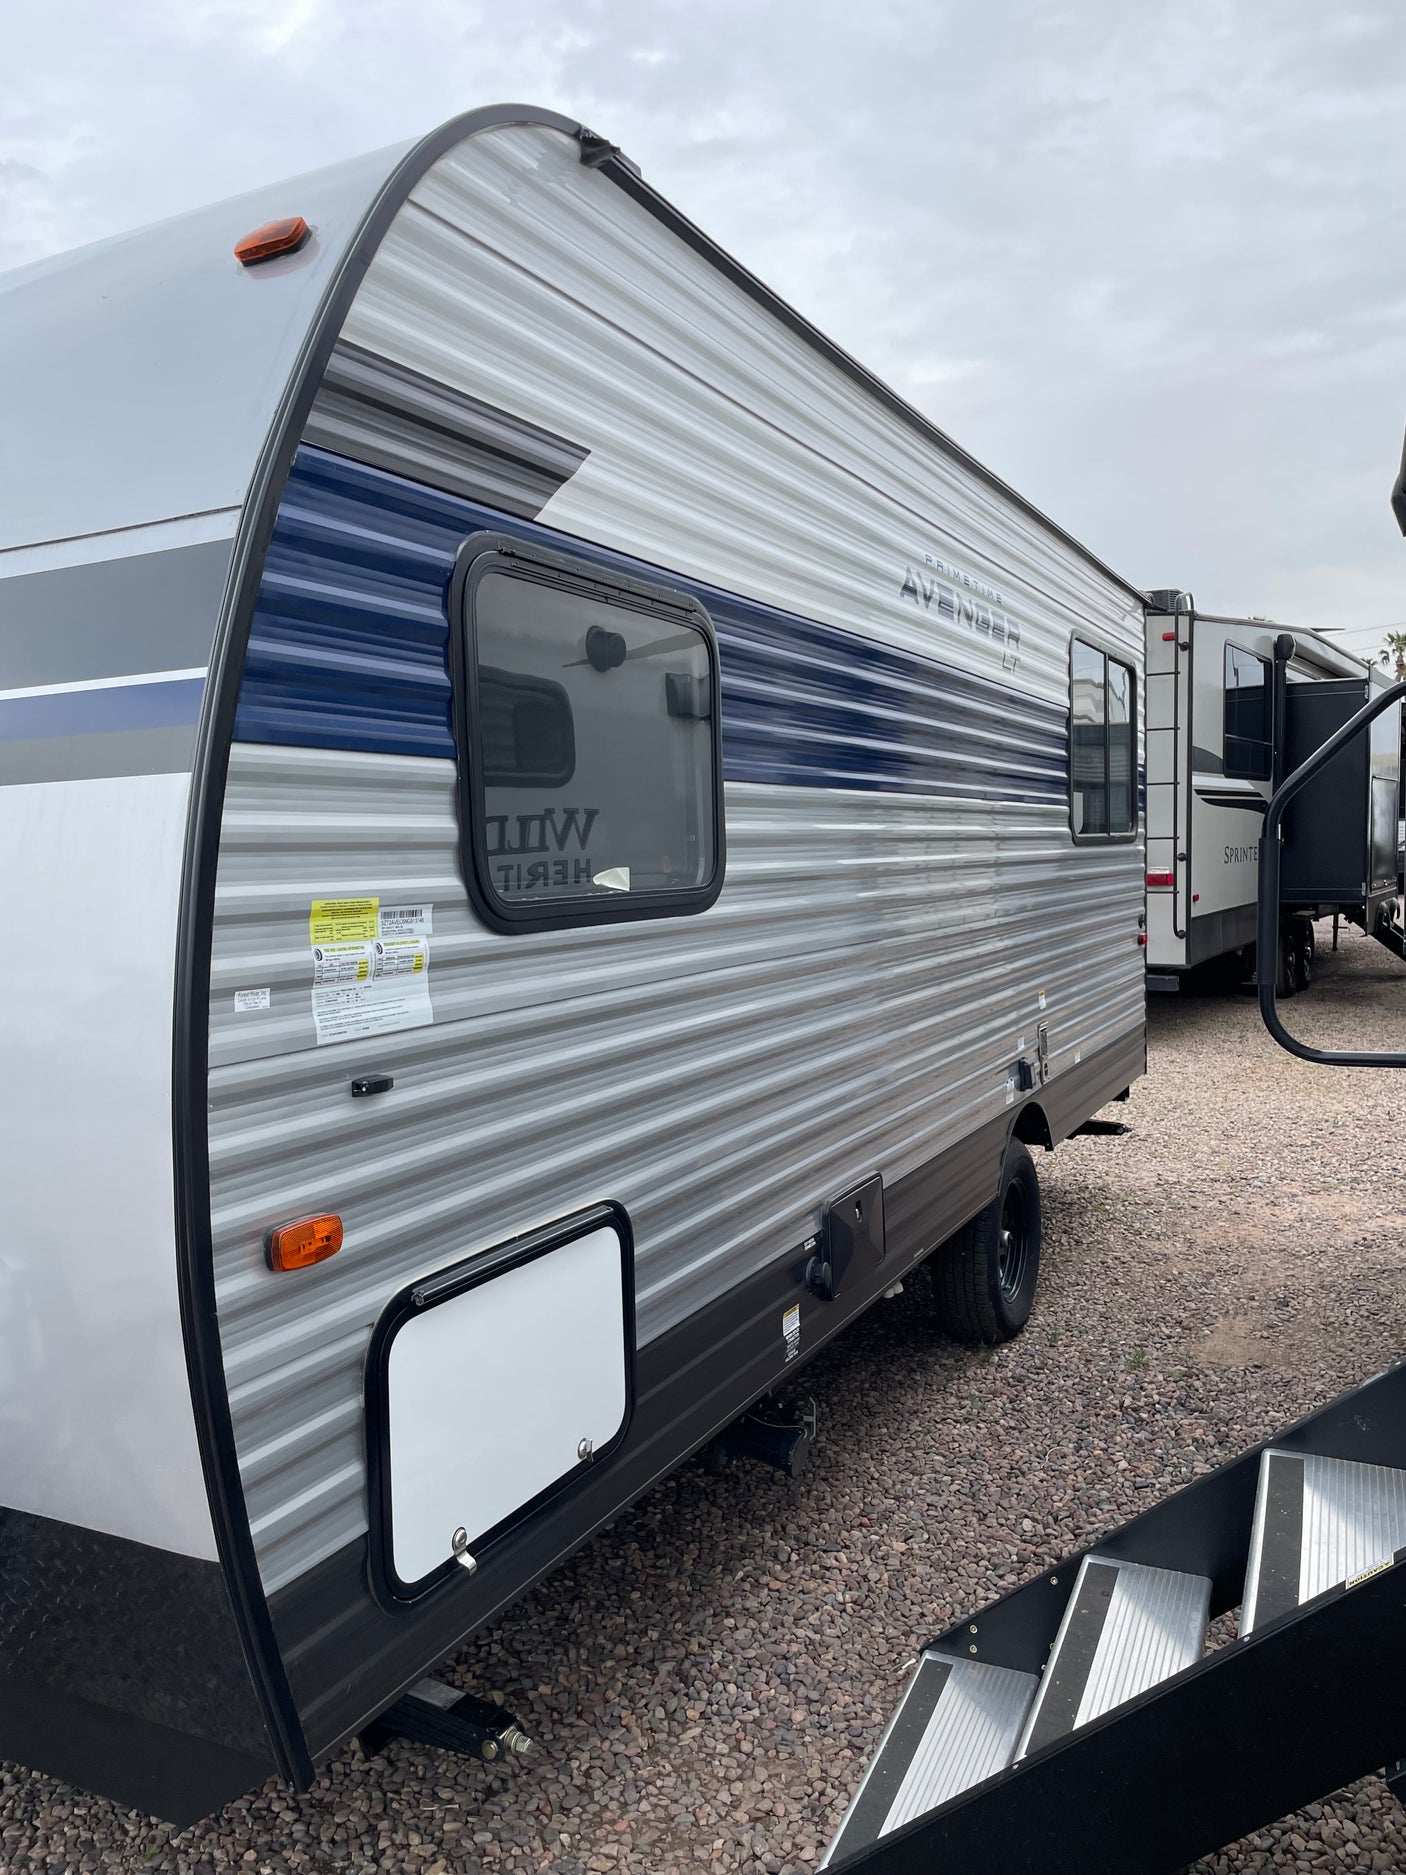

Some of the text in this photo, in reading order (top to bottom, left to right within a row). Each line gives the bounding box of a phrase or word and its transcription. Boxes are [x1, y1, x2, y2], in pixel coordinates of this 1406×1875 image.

[924, 553, 1002, 605] PRIMETIME
[900, 566, 1022, 650] AVENGER
[1002, 651, 1021, 673] LT
[1349, 1565, 1384, 1586] CAUTION
